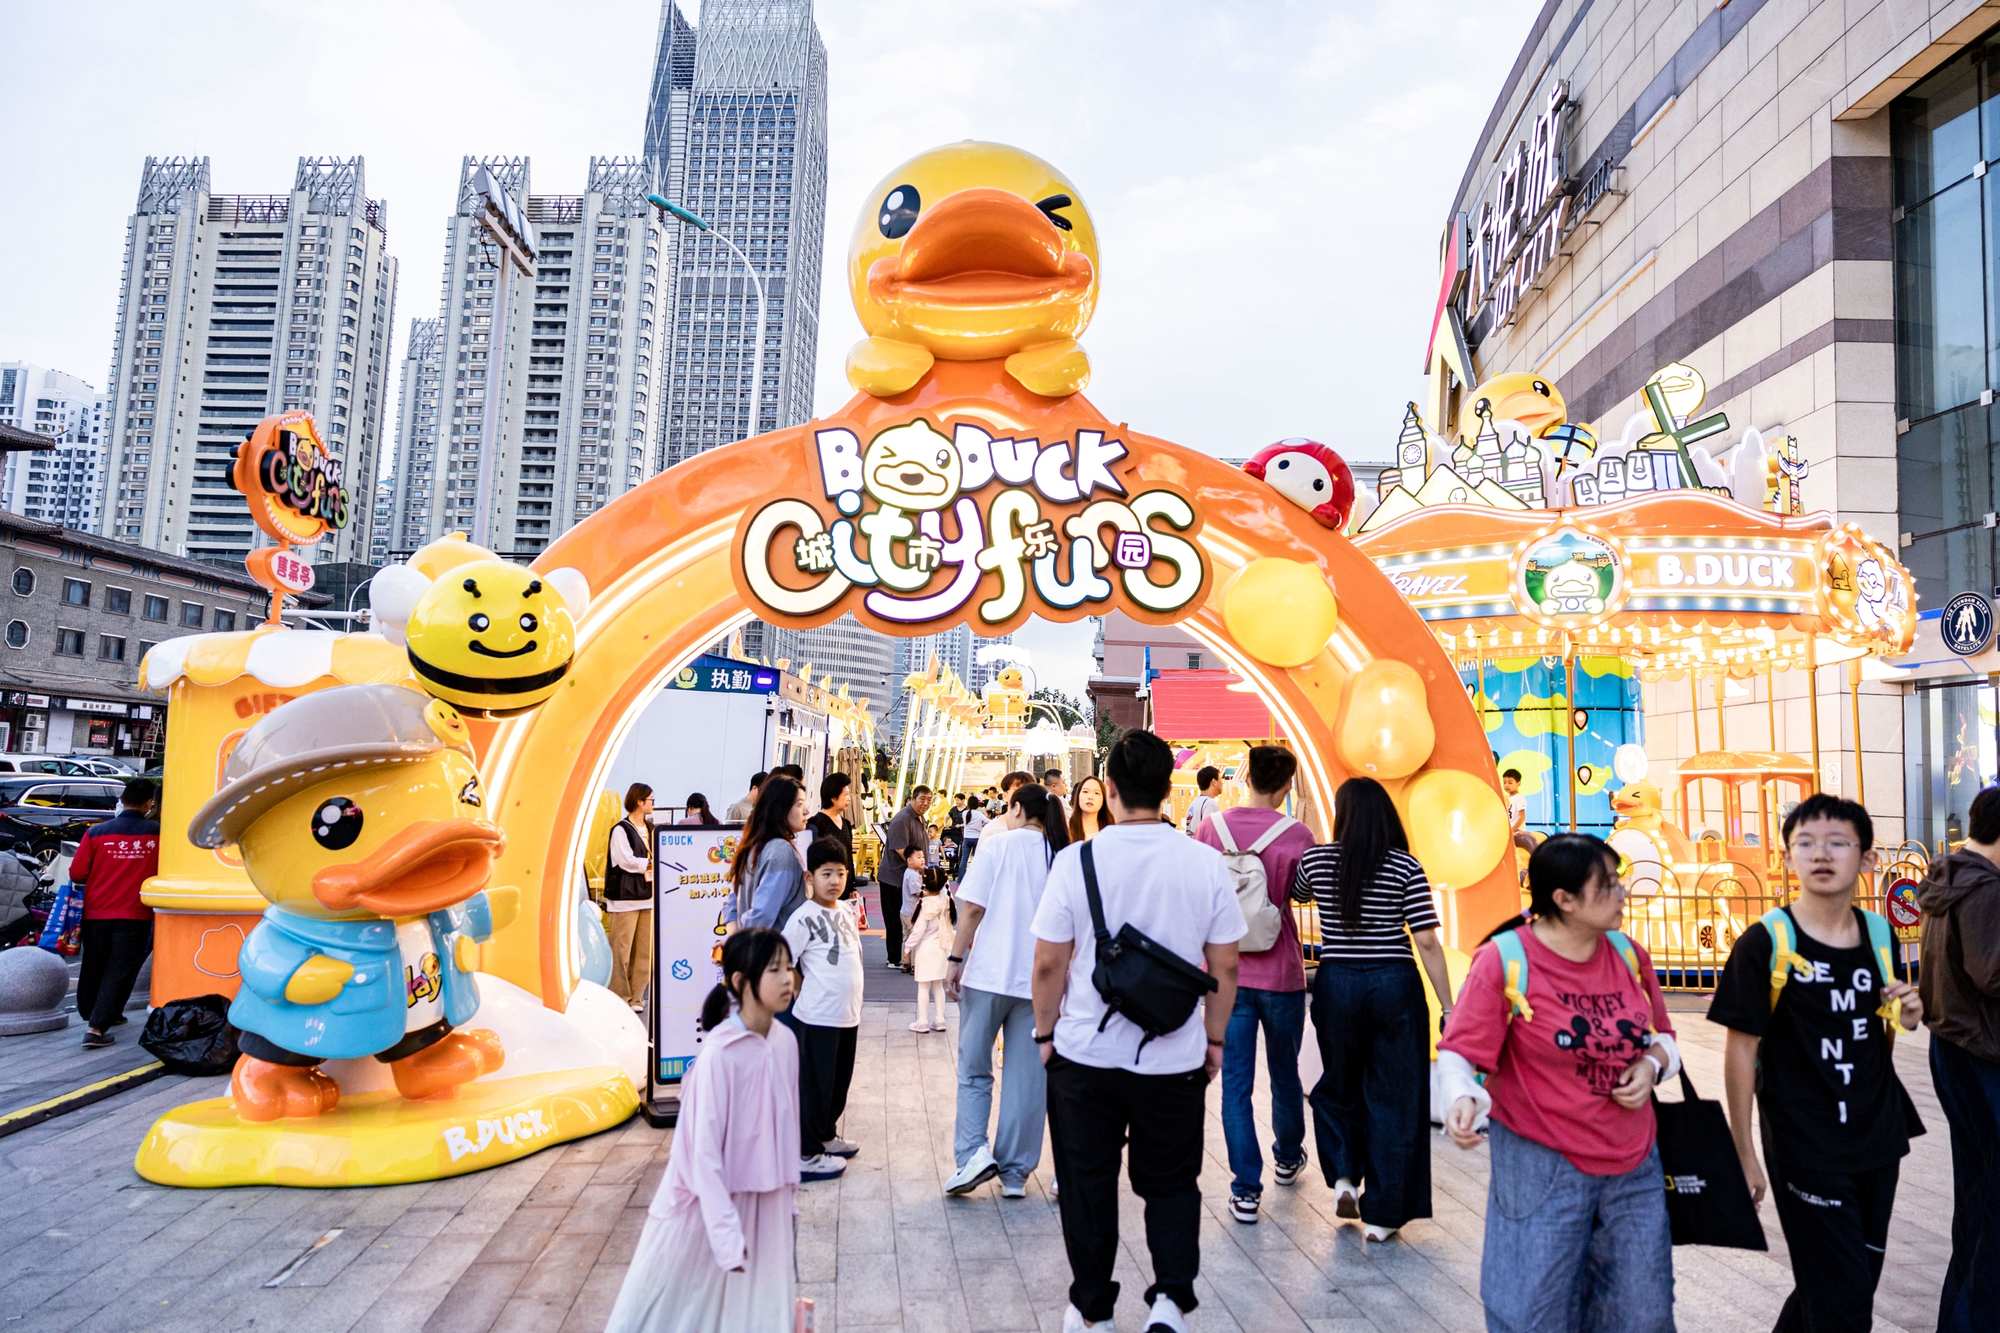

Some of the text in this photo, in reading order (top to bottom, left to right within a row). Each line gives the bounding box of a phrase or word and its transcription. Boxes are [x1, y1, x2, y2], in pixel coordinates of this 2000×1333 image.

[1490, 196, 1571, 337] JOY CITY
[1657, 553, 1796, 588] B.DUCK
[1953, 598, 1975, 608] GUNDAM
[1976, 600, 1988, 614] BASE
[1954, 640, 1982, 651] SATELLITE
[711, 669, 752, 691] 执勤
[443, 1109, 549, 1162] B.DUCK
